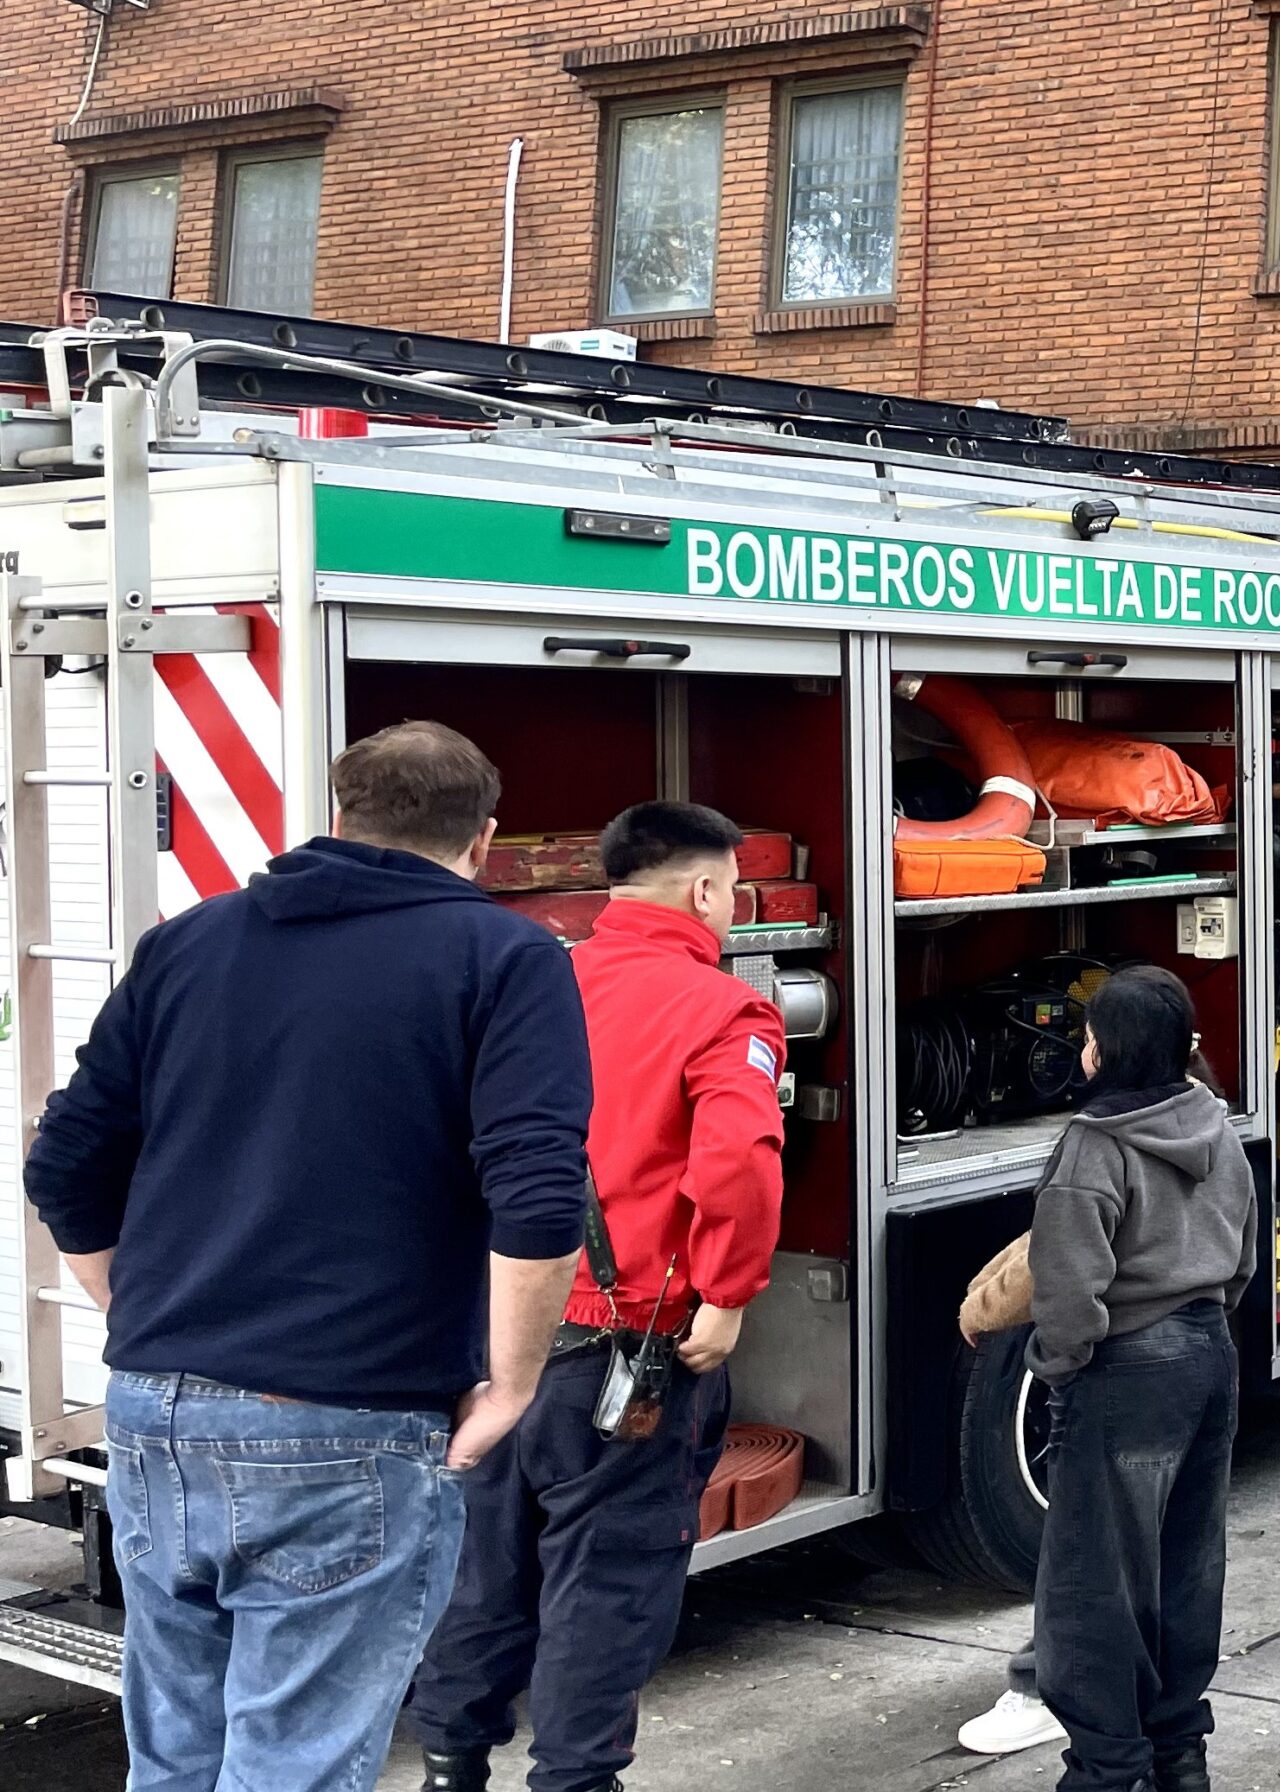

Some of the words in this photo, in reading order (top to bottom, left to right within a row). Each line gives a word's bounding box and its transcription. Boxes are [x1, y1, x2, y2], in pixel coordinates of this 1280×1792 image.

[686, 527, 976, 609] BOMBEROS
[987, 551, 1145, 619] VUELTA
[1153, 564, 1203, 622] DE
